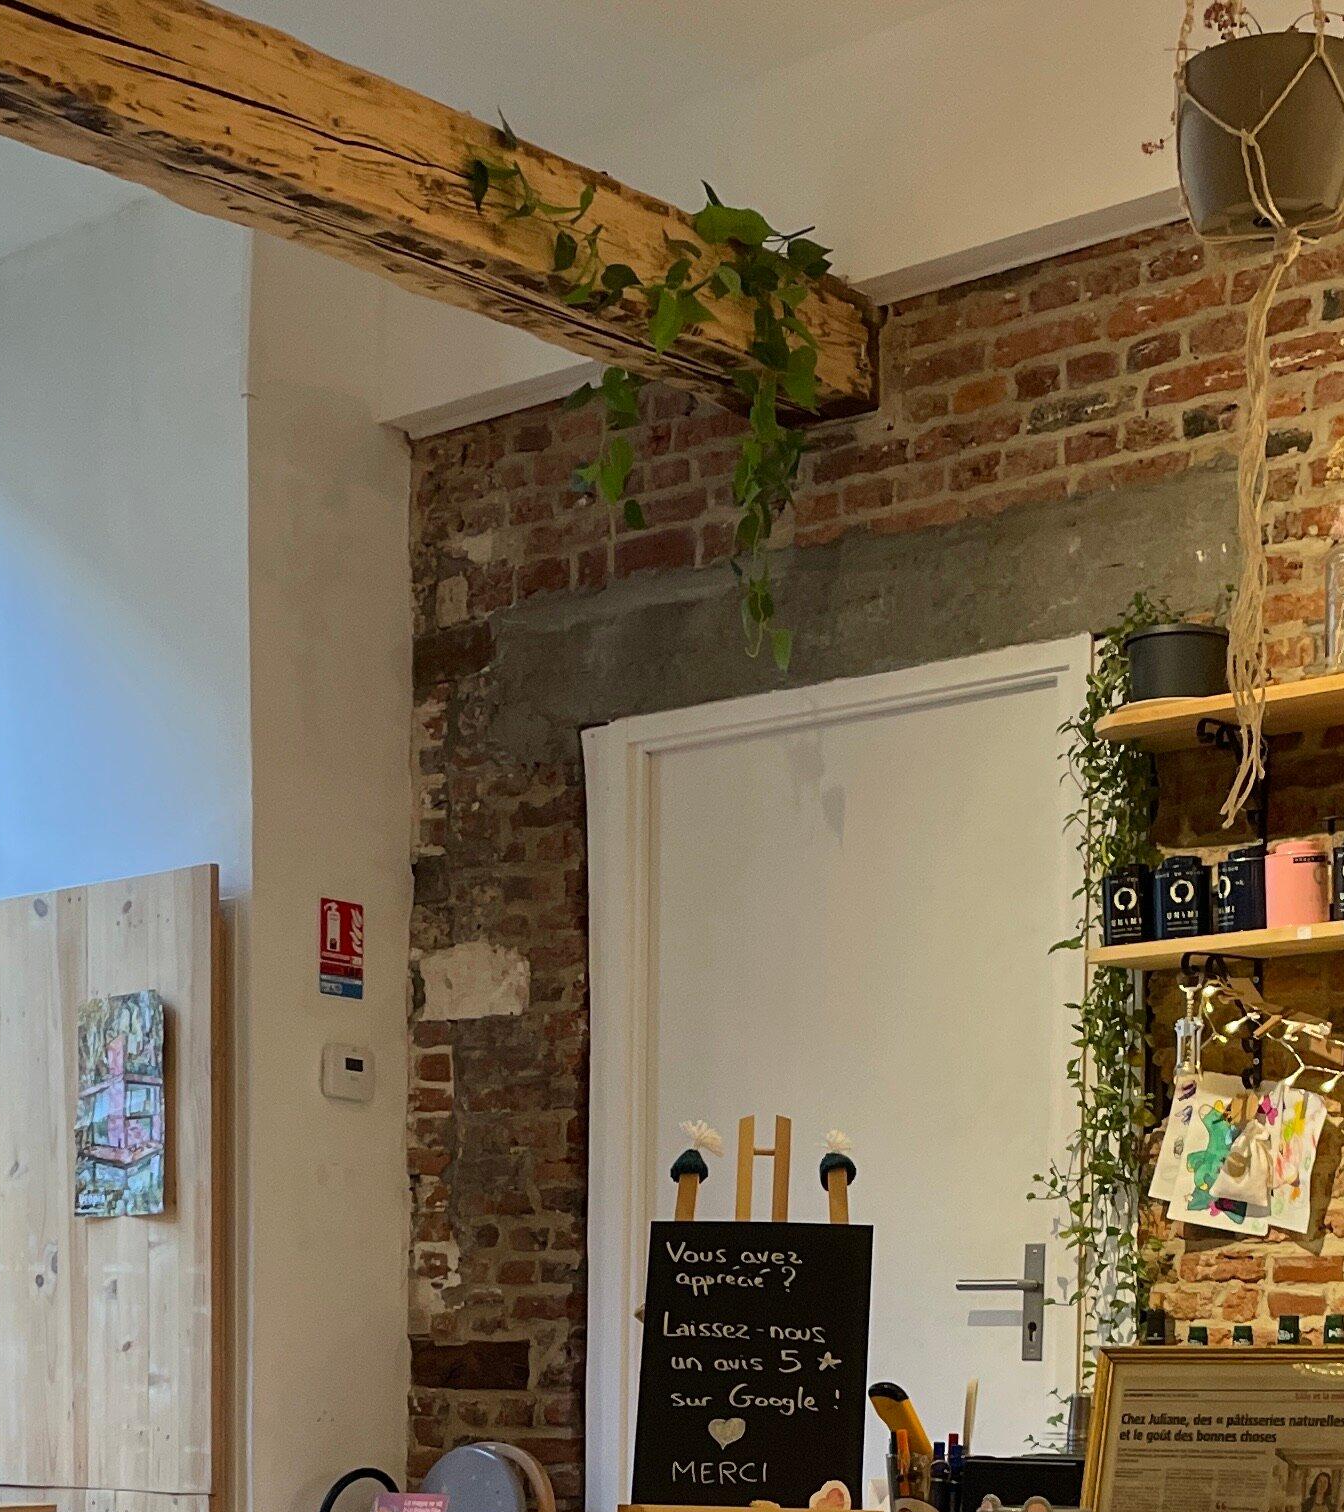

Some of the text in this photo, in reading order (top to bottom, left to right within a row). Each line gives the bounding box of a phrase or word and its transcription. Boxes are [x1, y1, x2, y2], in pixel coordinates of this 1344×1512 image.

[666, 1241, 803, 1264] Vous avez
[676, 1265, 796, 1297] apprécié ?
[671, 1349, 802, 1373] un avis 5
[670, 1392, 713, 1408] sur
[729, 1383, 819, 1416] Google
[1121, 1413, 1146, 1425] Chez
[1148, 1413, 1189, 1427] Juliane,
[1193, 1415, 1212, 1426] des
[1226, 1413, 1286, 1428] pâtisseries
[1119, 1429, 1277, 1444] et le goût des bonnes choses
[672, 1461, 768, 1485] MERCI
